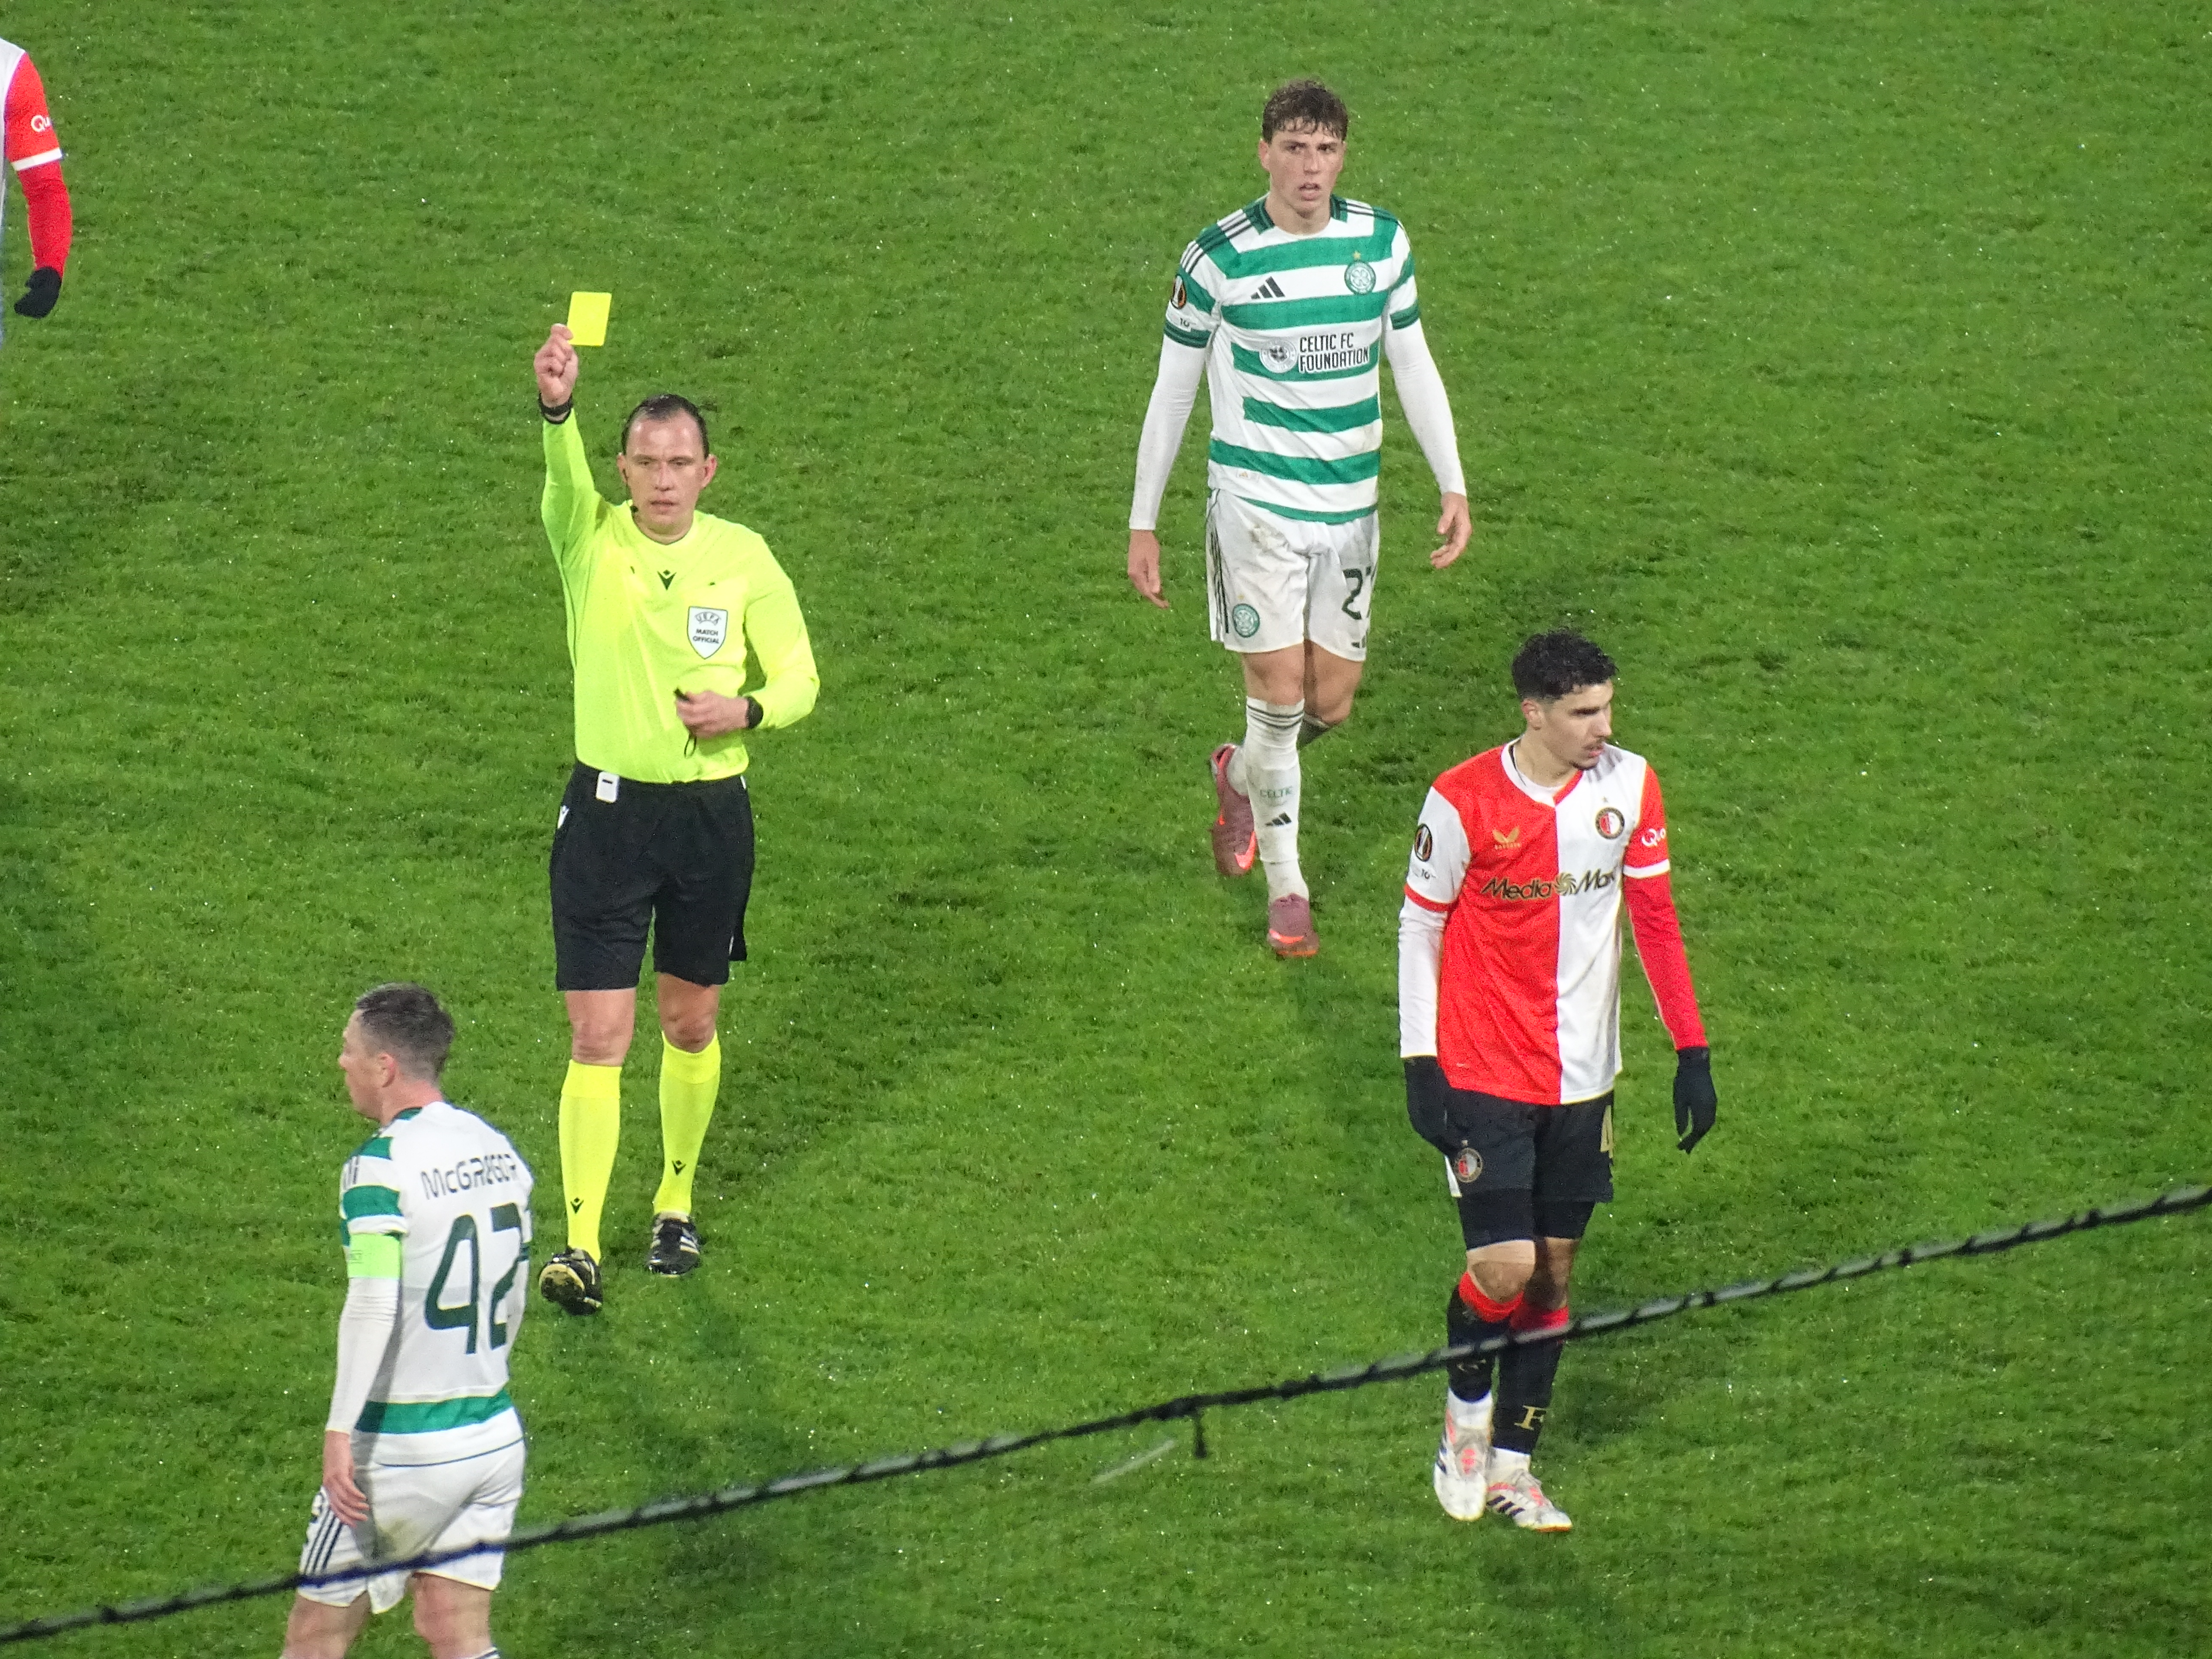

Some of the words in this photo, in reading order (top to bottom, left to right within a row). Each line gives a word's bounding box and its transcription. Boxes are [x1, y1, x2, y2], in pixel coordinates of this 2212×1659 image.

[1300, 334, 1336, 353] CELTIC
[1341, 332, 1354, 349] FC
[1300, 346, 1369, 371] FOUNDATION
[424, 1202, 521, 1354] 42
[1514, 1405, 1547, 1431] F
